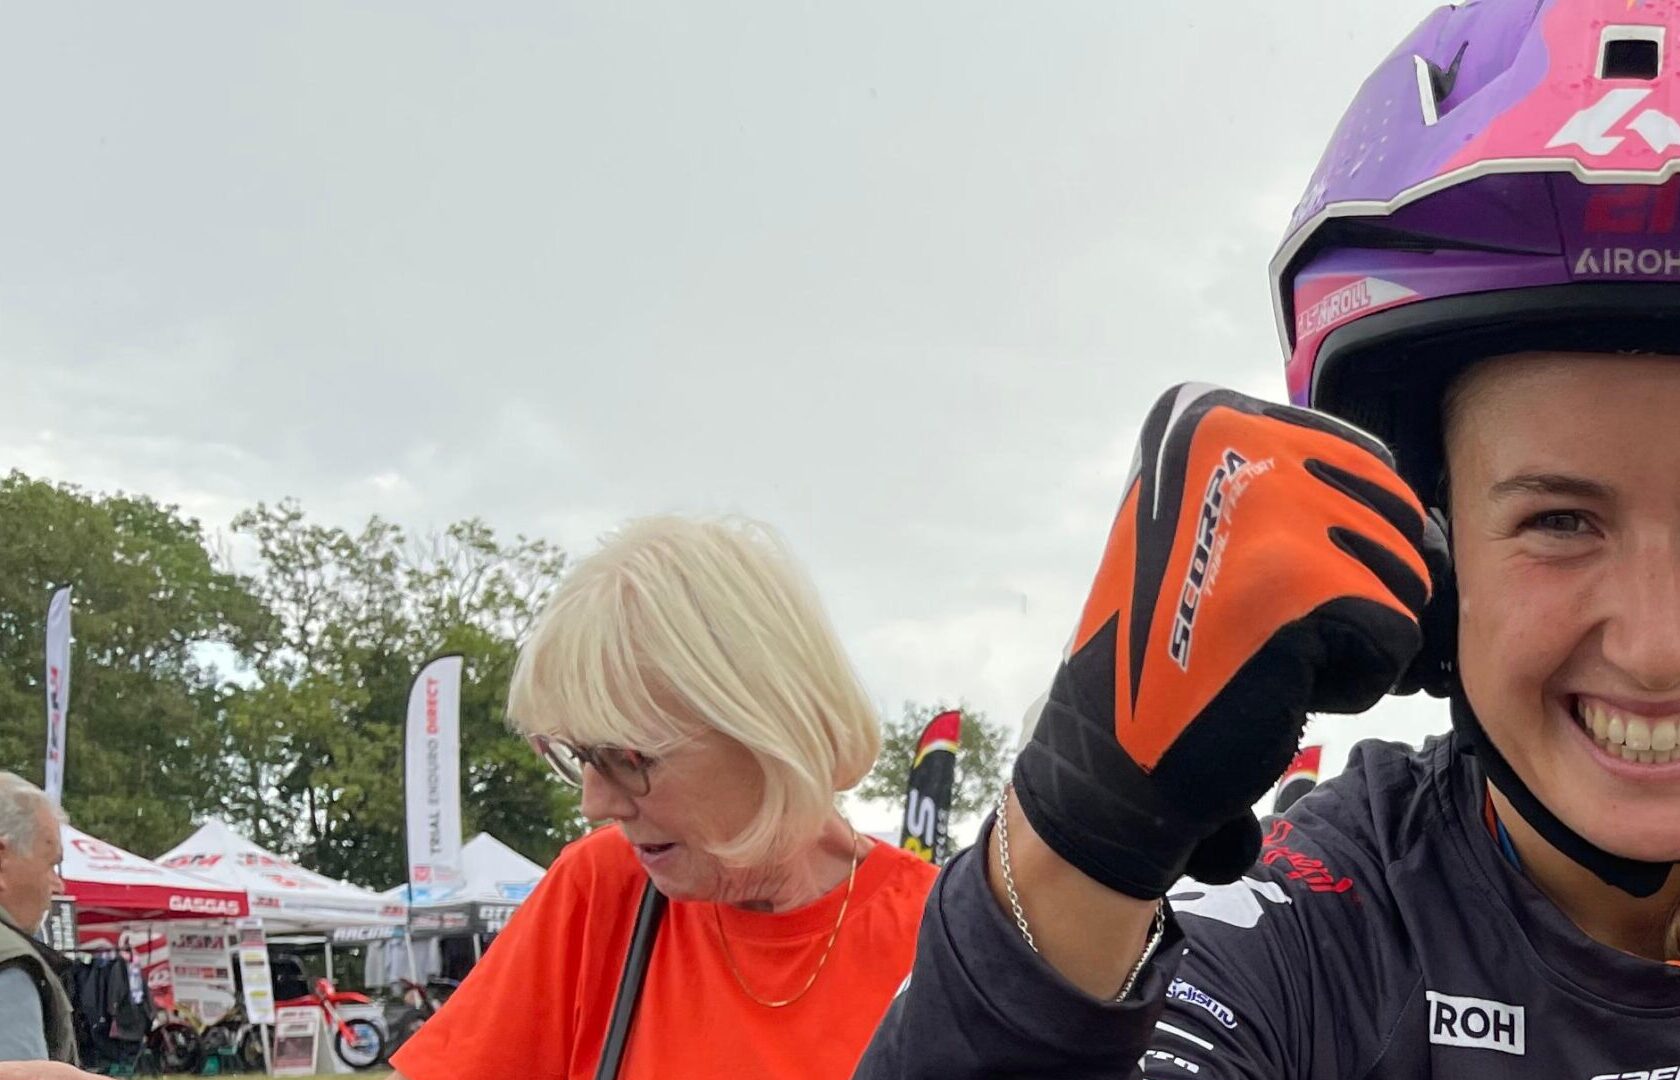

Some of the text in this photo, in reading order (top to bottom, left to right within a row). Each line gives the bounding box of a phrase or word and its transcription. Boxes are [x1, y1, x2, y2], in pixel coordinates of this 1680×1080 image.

[1167, 447, 1248, 673] SCORPA
[425, 677, 442, 855] TRIAL ENDURO DIRECT
[168, 893, 241, 916] GASGAS
[1433, 1005, 1518, 1046] ROH
